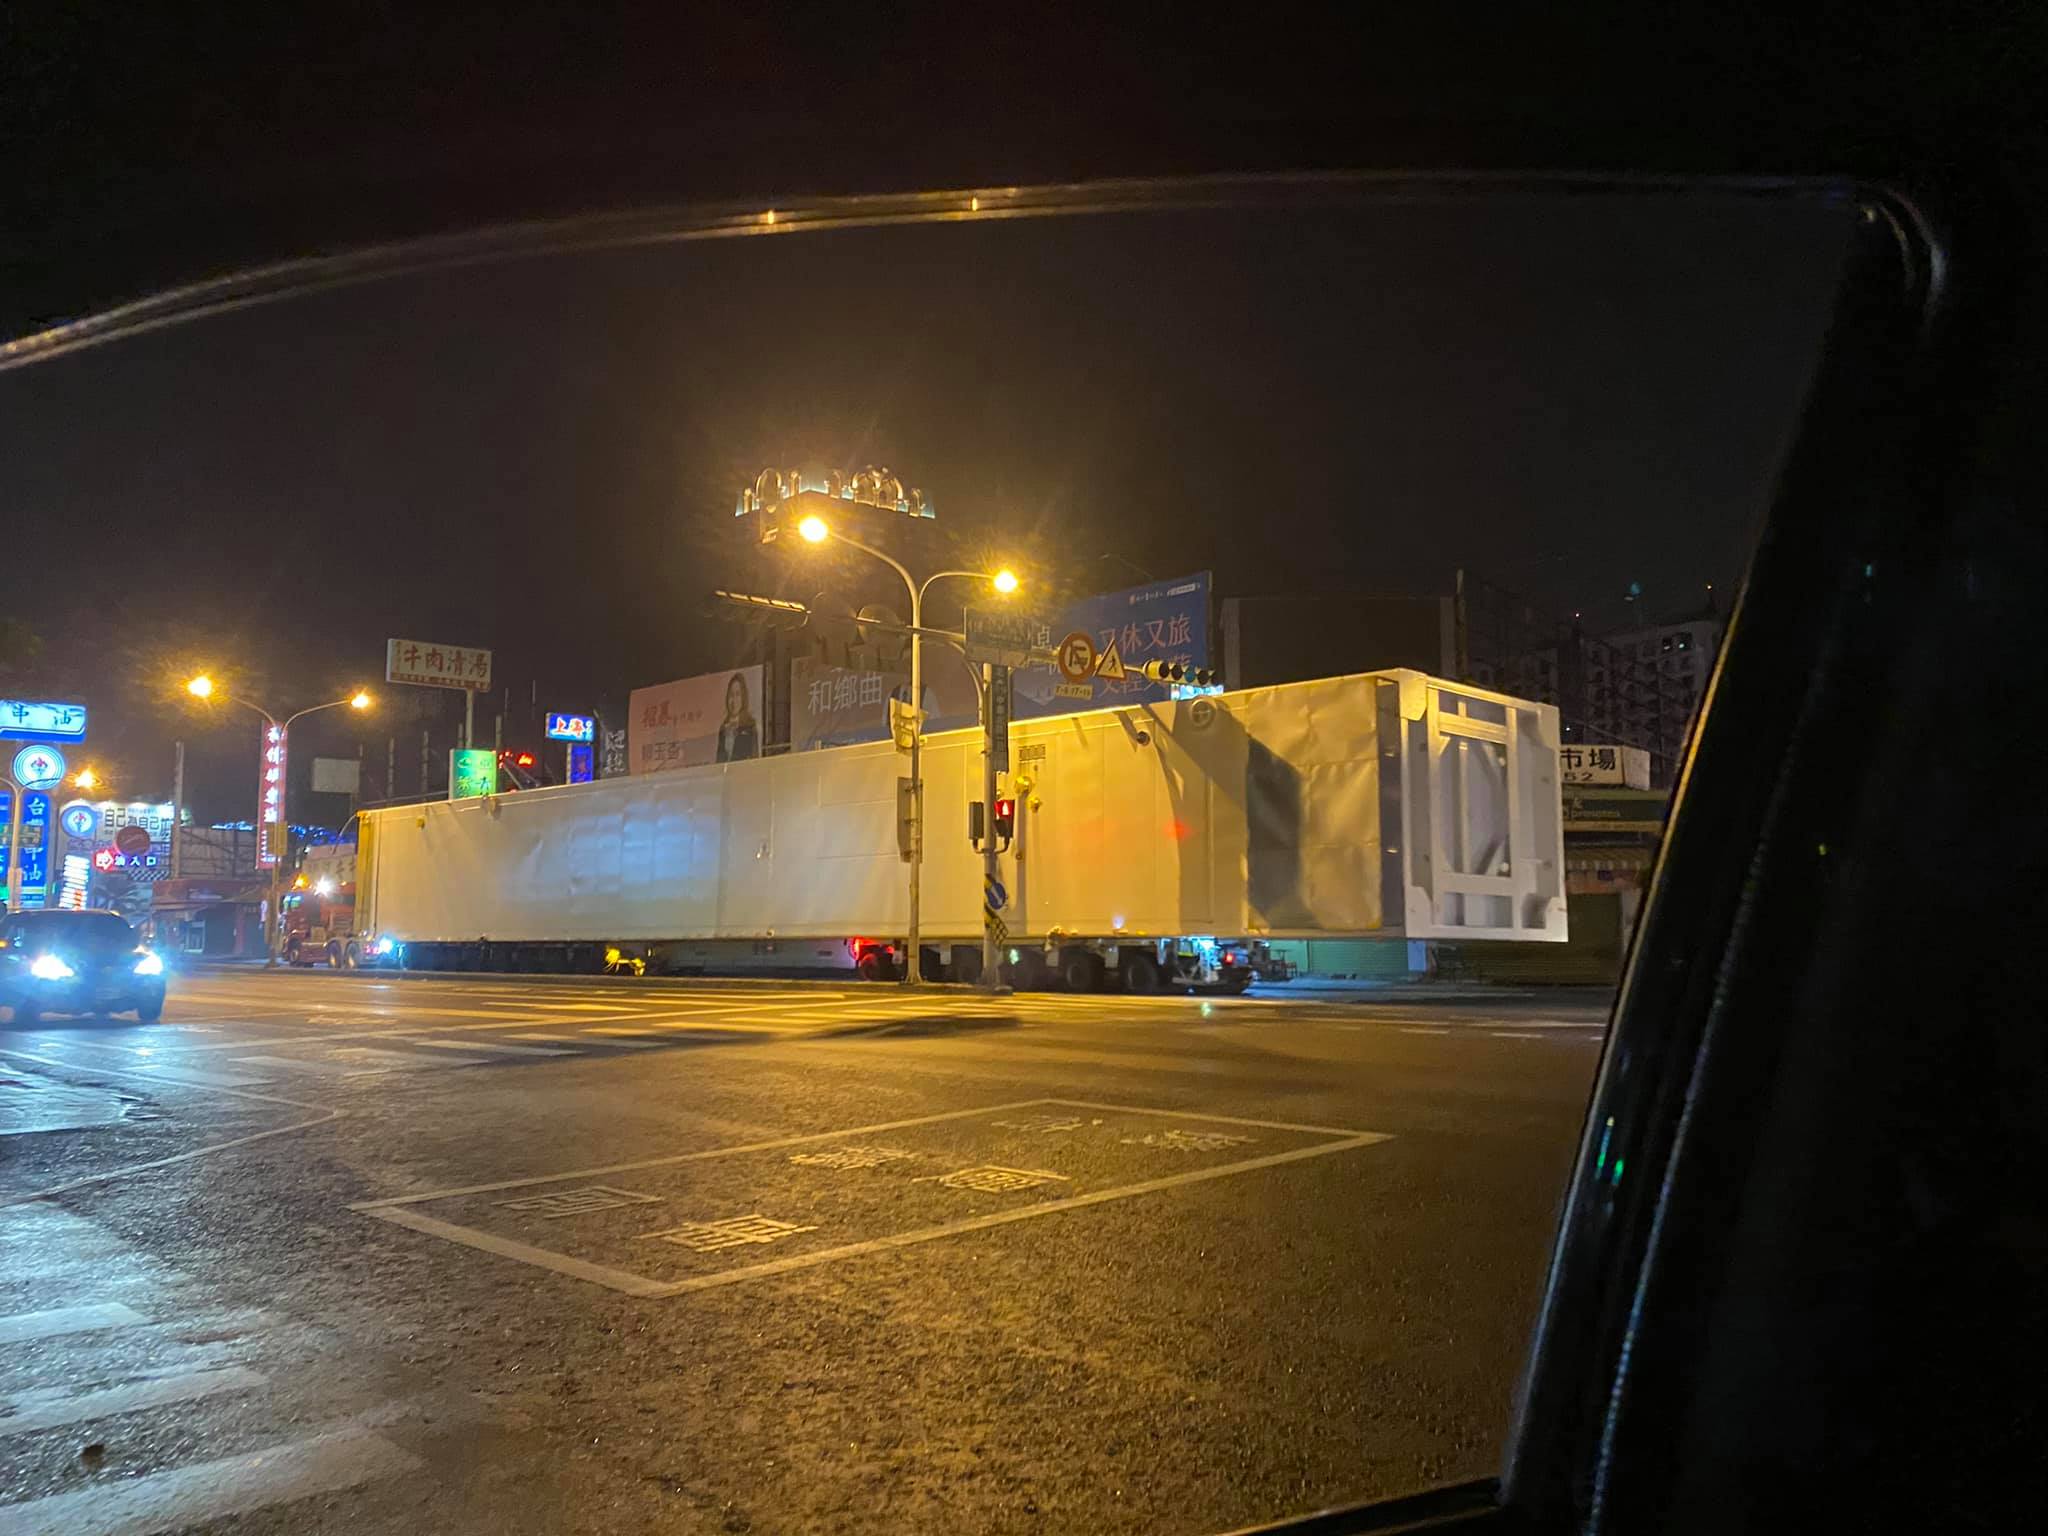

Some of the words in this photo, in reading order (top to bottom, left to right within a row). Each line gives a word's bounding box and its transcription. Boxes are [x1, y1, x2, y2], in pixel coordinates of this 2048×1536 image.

[404, 645, 487, 678] 牛肉清湯
[1560, 748, 1616, 770] 市場
[21, 797, 46, 882] 台中油
